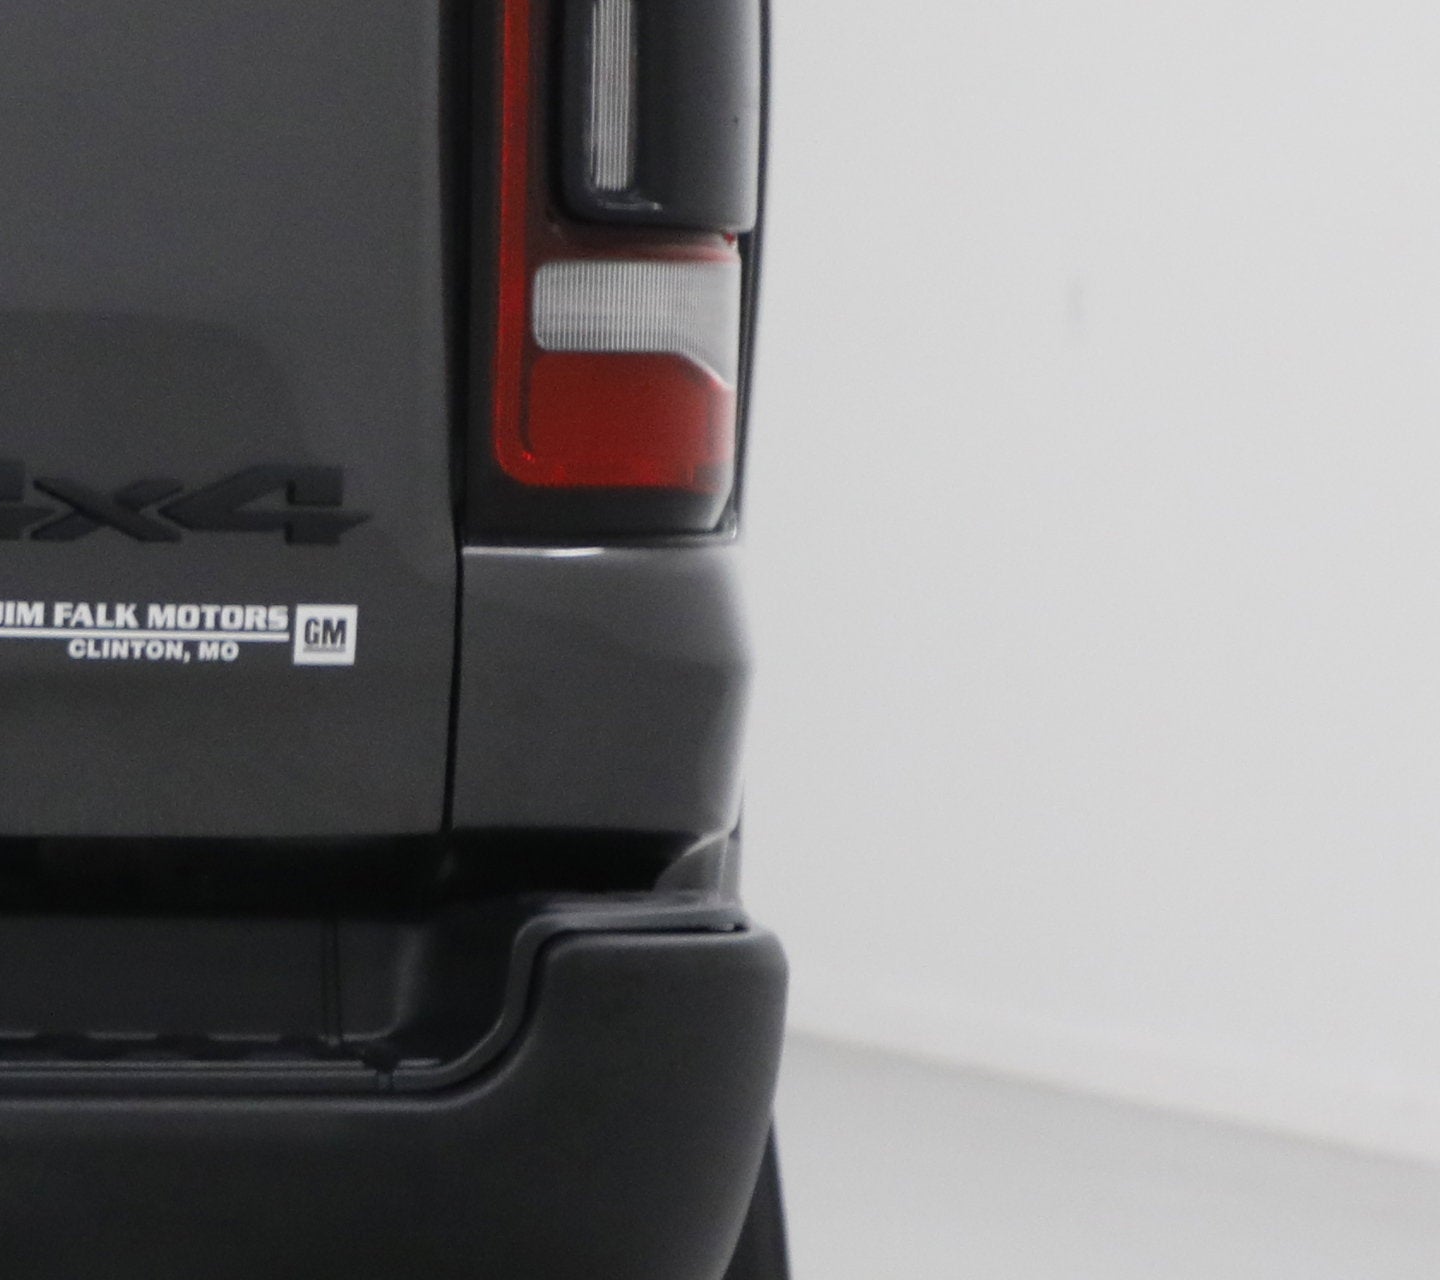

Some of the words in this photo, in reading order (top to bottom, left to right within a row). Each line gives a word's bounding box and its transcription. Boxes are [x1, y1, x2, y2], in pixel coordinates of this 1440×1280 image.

[53, 602, 140, 629] FALK
[147, 604, 289, 632] MOTORS
[304, 618, 347, 647] GM
[68, 639, 191, 664] CLINTON,
[198, 642, 240, 661] MO
